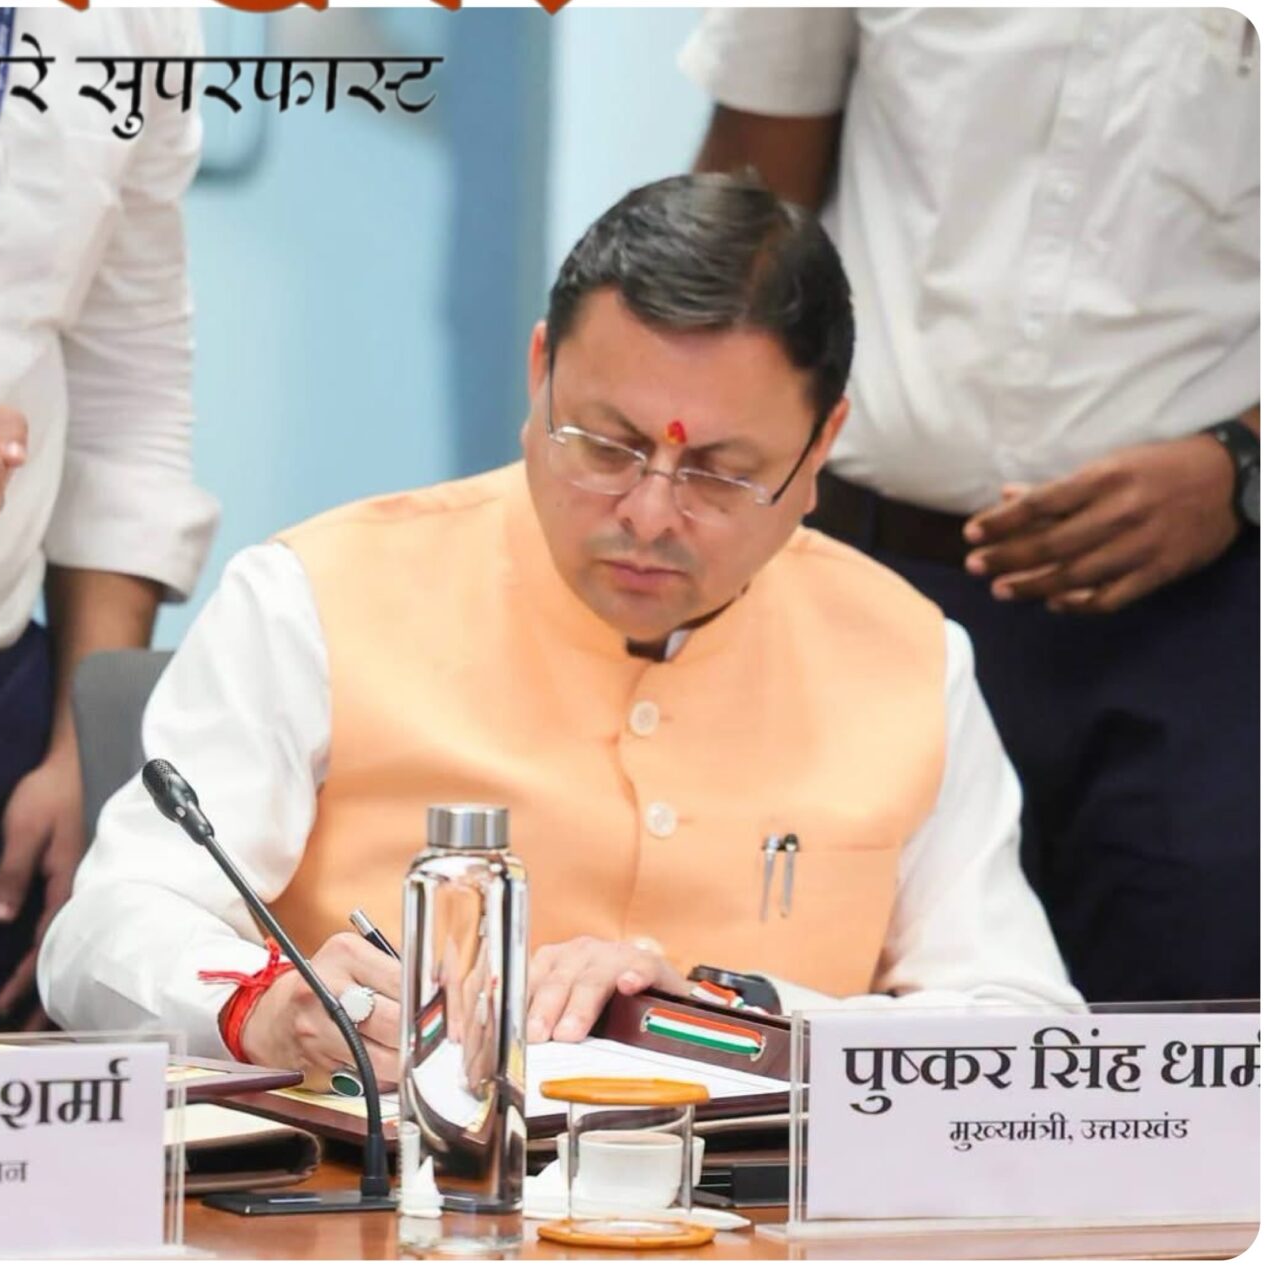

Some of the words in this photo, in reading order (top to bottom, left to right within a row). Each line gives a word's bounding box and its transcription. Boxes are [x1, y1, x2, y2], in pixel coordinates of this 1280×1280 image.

[0, 1057, 131, 1128] शर्मा
[842, 1045, 1018, 1115] पुष्कर
[1030, 1026, 1147, 1093] सिंह
[1160, 1028, 1260, 1089] धाम
[949, 1111, 1074, 1152] मुख्यमंत्री,
[1080, 1111, 1190, 1140] उत्तराखंड
